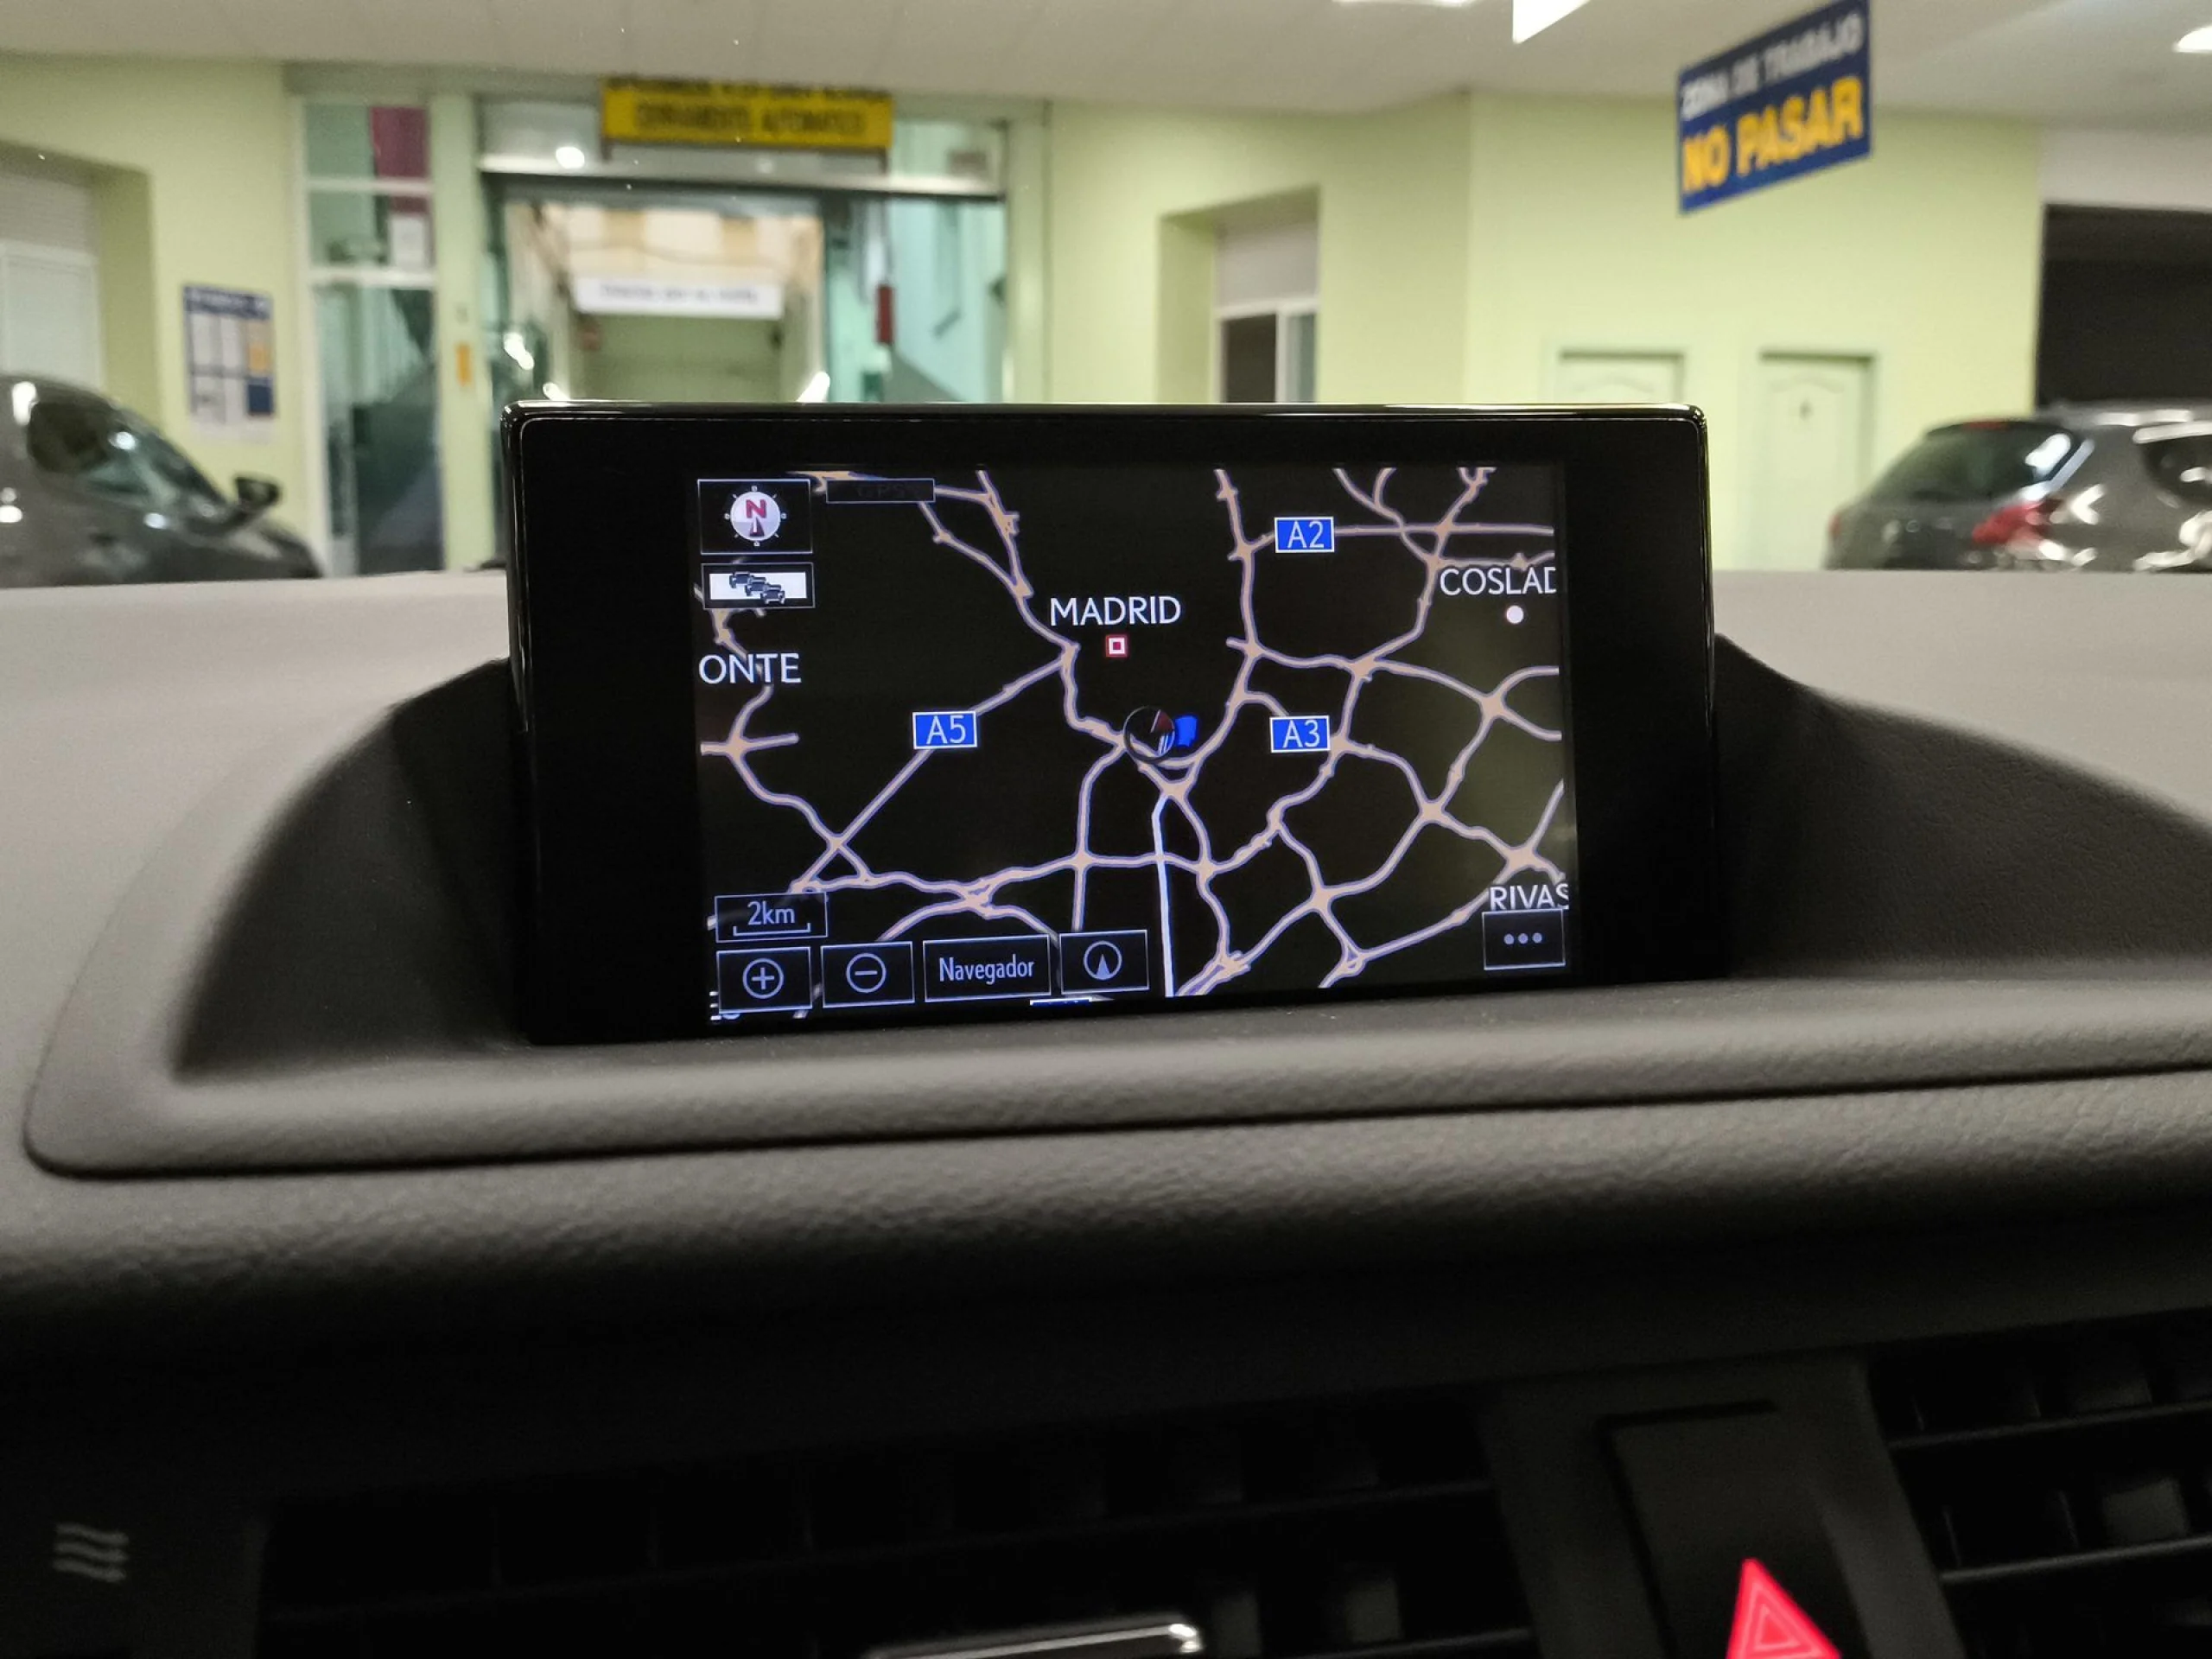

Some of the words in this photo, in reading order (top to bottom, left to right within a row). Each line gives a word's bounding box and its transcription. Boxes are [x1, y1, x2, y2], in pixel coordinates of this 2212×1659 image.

[1682, 124, 1731, 194] NO
[1736, 76, 1863, 178] PASAR
[746, 499, 767, 518] N
[1287, 521, 1325, 549] A2
[1440, 565, 1557, 596] COSLAD
[1050, 596, 1181, 626] MADRID
[698, 653, 802, 684] ONTE
[926, 715, 966, 745] A5
[1282, 719, 1320, 748] A3
[1489, 883, 1569, 911] RIVAS
[747, 900, 796, 925] 2km
[938, 953, 1035, 985] Navegador
